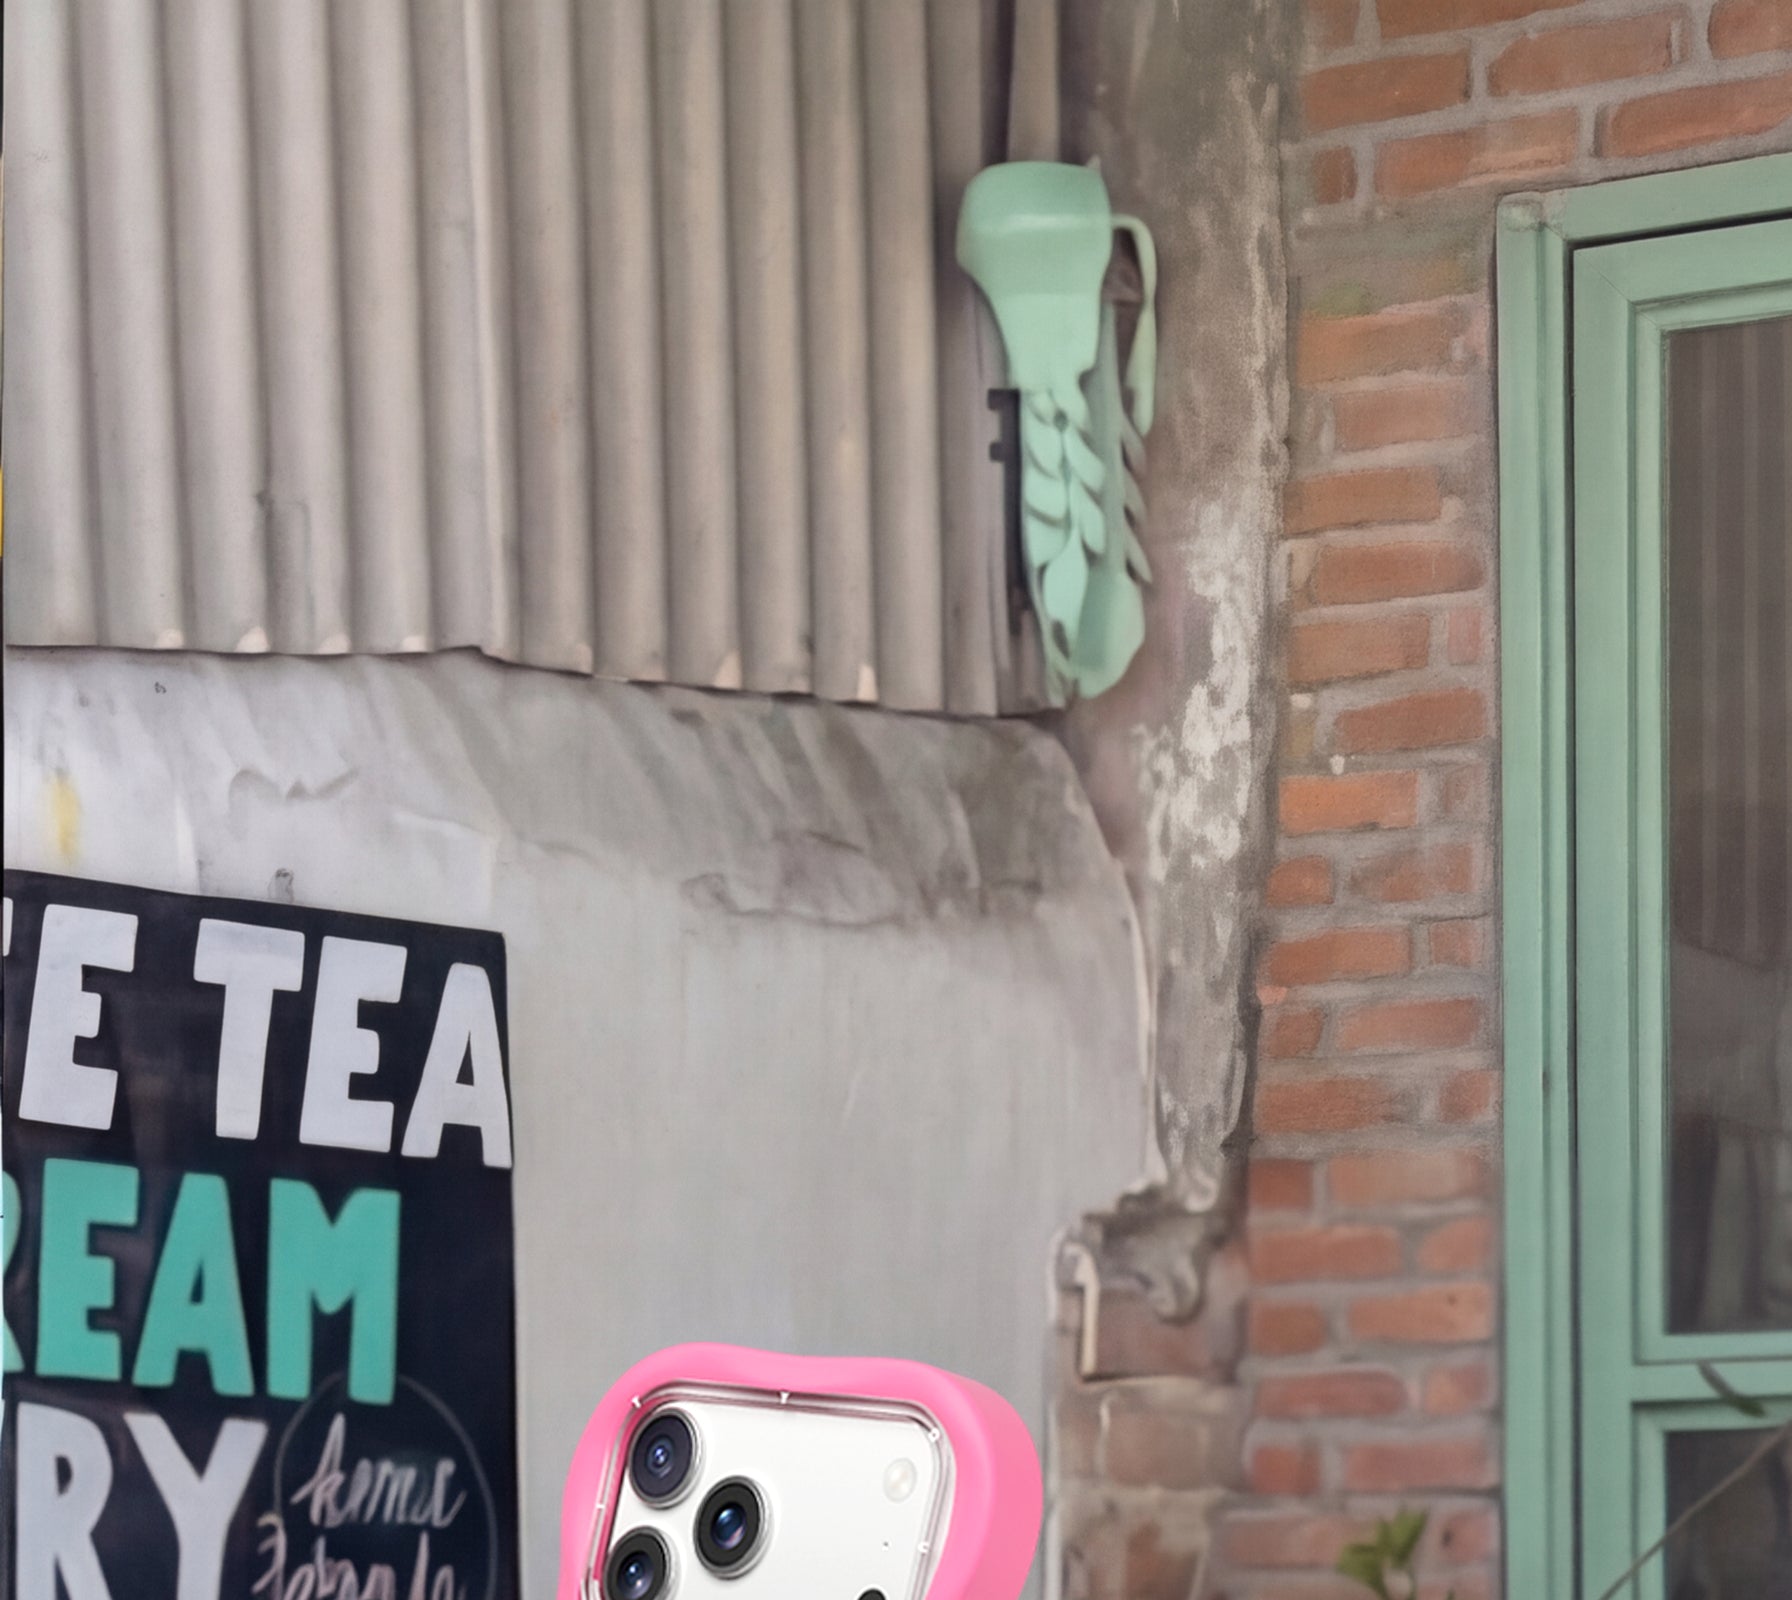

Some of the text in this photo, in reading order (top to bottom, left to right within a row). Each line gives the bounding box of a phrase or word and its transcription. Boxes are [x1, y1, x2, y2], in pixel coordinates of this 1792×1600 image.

[3, 897, 512, 1169] E TEA
[3, 1157, 401, 1404] EAM
